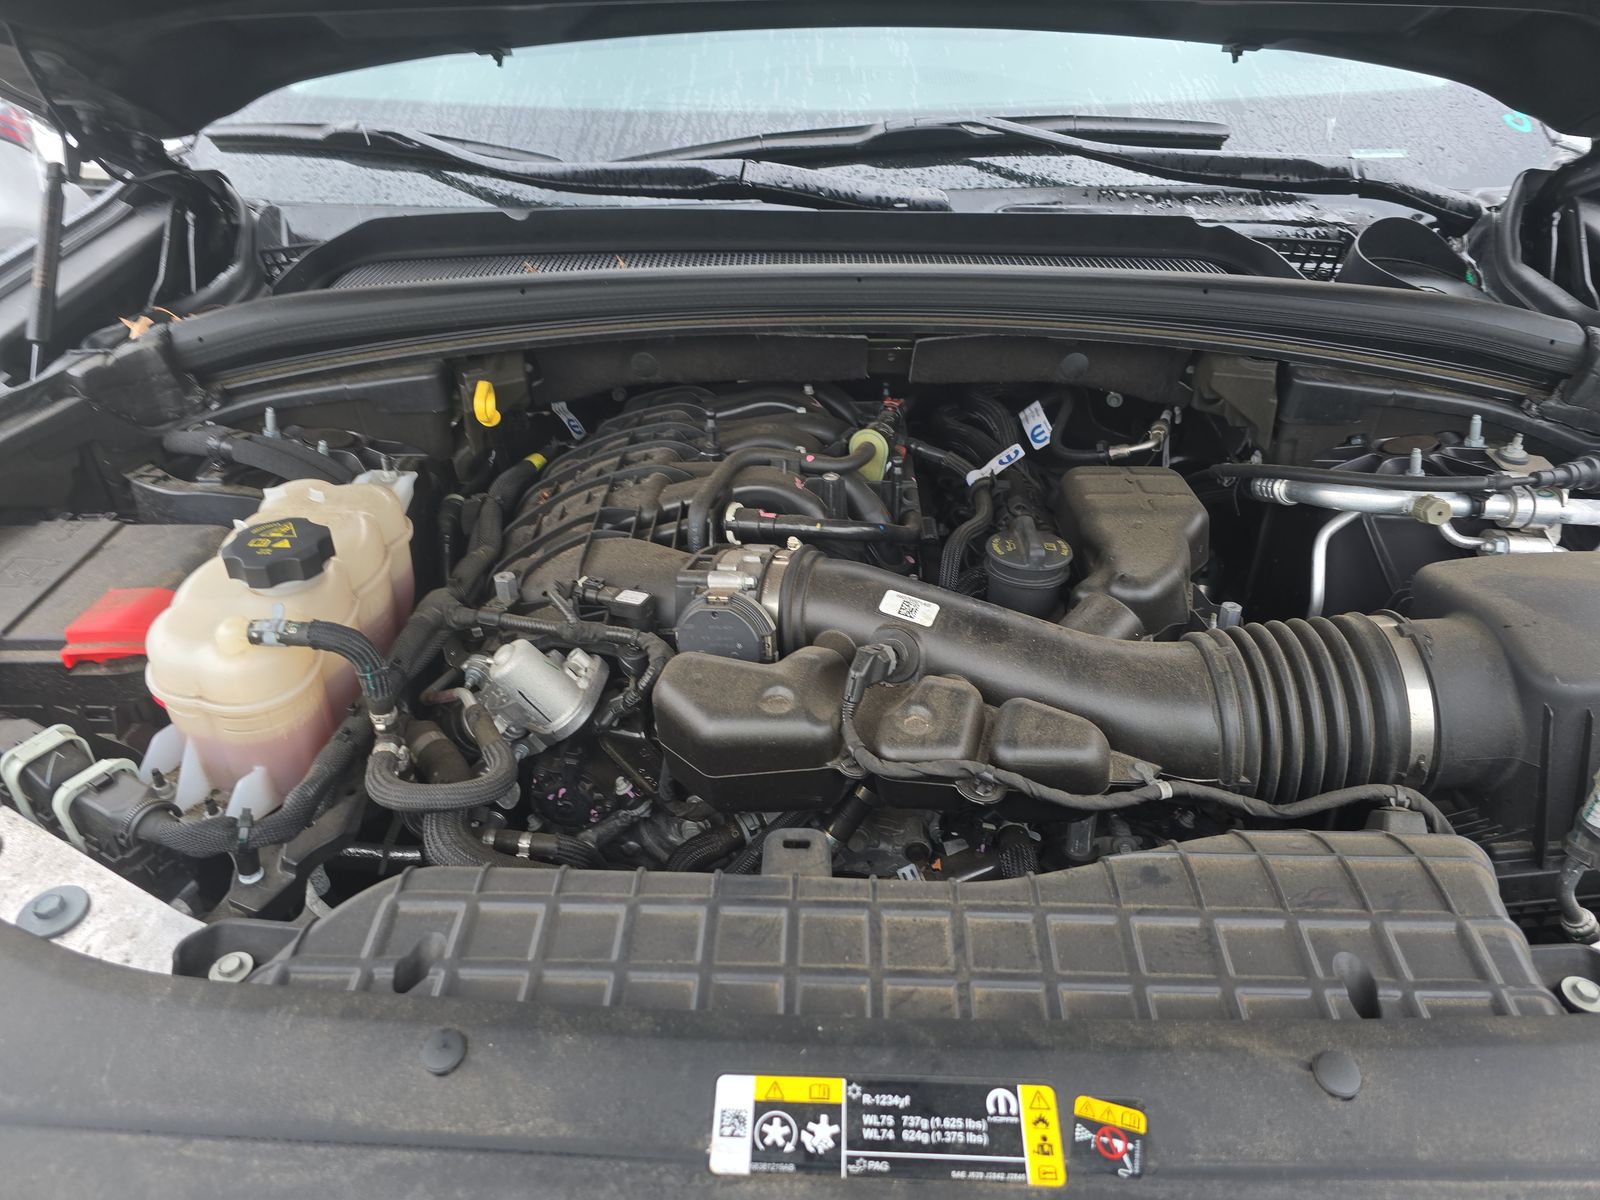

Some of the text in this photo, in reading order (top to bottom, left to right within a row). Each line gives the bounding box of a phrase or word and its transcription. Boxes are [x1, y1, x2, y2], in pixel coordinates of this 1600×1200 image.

[862, 1093, 911, 1109] R-1234yf
[862, 1114, 989, 1132] WL75 737g (1.625 lbs)
[862, 1128, 990, 1146] WL74 624g (1.375 lbs)
[868, 1160, 891, 1173] PAG
